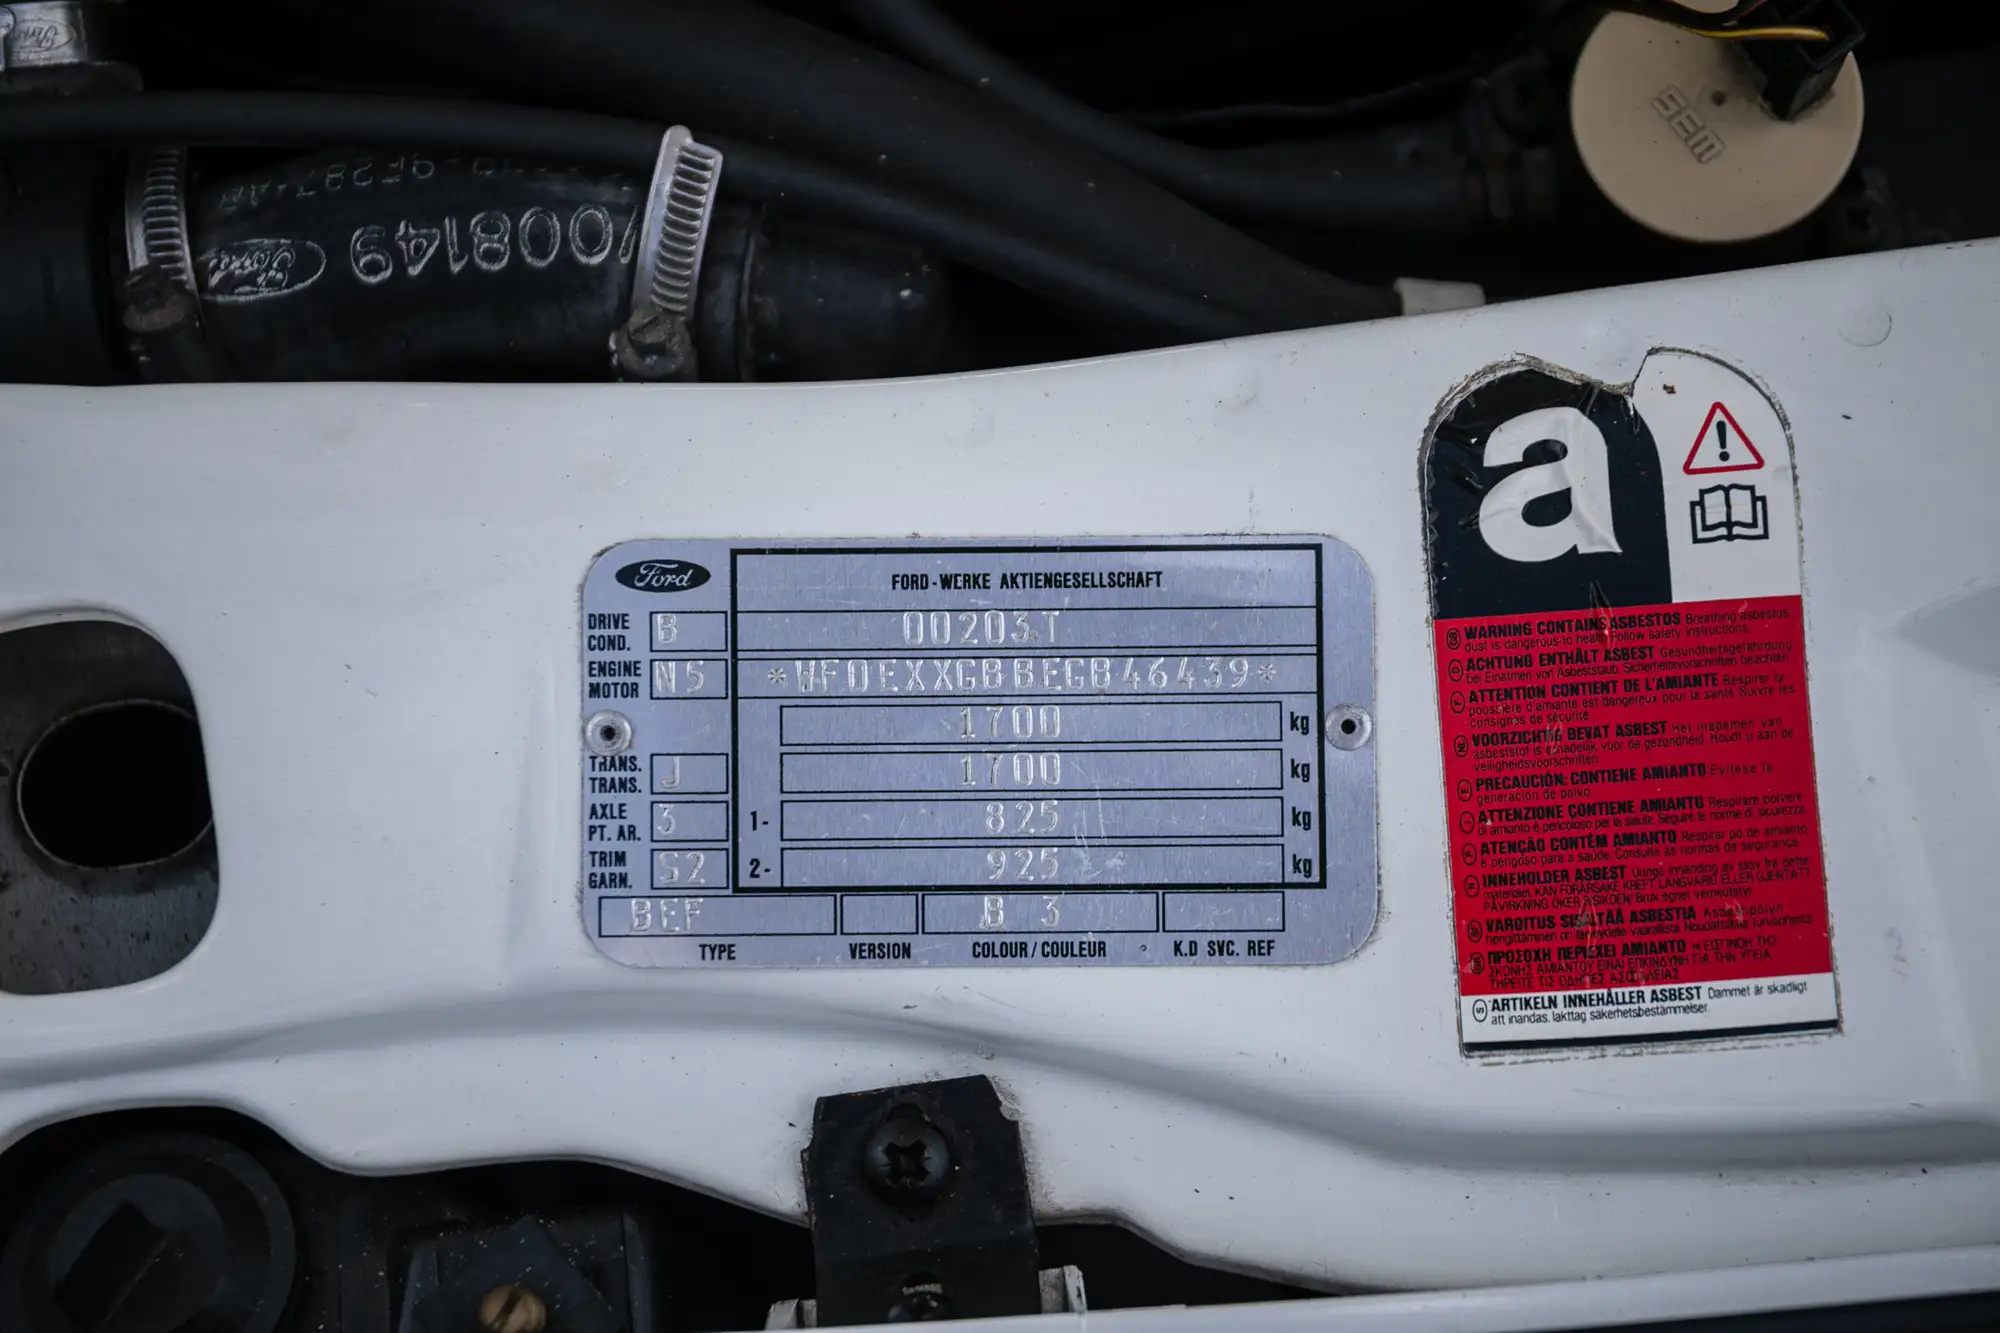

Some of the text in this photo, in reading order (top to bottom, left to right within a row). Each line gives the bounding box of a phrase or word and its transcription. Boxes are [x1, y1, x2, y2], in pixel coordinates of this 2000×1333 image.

[1479, 405, 1623, 563] a
[634, 562, 693, 589] Ford
[1000, 571, 1163, 589] AKTIENGESELLSCHAFT
[588, 613, 630, 630] DRIVE
[656, 613, 678, 645] B
[1463, 621, 1532, 639] WARNING
[1535, 616, 1606, 634] CONTAINS
[1608, 611, 1681, 630] ASBESTOS
[588, 635, 631, 652] COND.
[1463, 640, 1488, 652] dust
[1490, 639, 1501, 650] is
[1503, 635, 1558, 652] dangerous
[1648, 627, 1680, 642] safety
[588, 661, 642, 678] ENGINE
[1465, 645, 1655, 671] ACHTUNG ENTHÄLT ASBEST
[588, 682, 640, 700] MOTOR
[1467, 684, 1546, 703] ATTENTION
[1550, 679, 1618, 698] CONTIENT
[1622, 677, 1640, 693] DE
[1645, 672, 1719, 691] L'AMIANTE
[959, 705, 1310, 739] 1700 kg
[1529, 712, 1542, 724] de
[1566, 723, 1611, 741] BEVAT
[1614, 720, 1669, 738] ASBEST
[960, 752, 1311, 787] 1700 kg
[1569, 766, 1638, 786] CONTIENE
[1642, 762, 1706, 781] AMIANTO
[589, 777, 642, 794] TRANS.
[1542, 788, 1556, 800] de
[588, 803, 627, 820] AXLE
[656, 803, 676, 835] 3
[985, 799, 1060, 834] 825
[1291, 807, 1312, 831] kg
[1477, 804, 1564, 824] ATTENZIONE
[1567, 799, 1636, 818] CONTIENE
[1638, 794, 1704, 813] AMIANTO
[588, 825, 641, 842] PT. AR.
[1478, 834, 1546, 859] ATENÇÃO
[1549, 830, 1608, 851] CONTÉM
[1612, 829, 1677, 847] AMIANTO
[588, 851, 626, 868] TRIM
[985, 846, 1060, 882] 925
[1292, 855, 1313, 878] kg
[588, 872, 633, 890] GARN.
[1481, 864, 1627, 888] INNEHOLDER ASBEST
[629, 897, 705, 935] BEF
[1485, 914, 1556, 933] VAROITUS
[1629, 905, 1696, 924] ASBESTIA
[699, 943, 737, 961] TYPE
[849, 941, 912, 961] VERSION
[1207, 940, 1240, 957] SVC.
[1247, 940, 1276, 957] REF
[1487, 946, 1551, 964] ΠΡΟΣΟΧΗ
[1490, 994, 1557, 1012] ARTIKELN
[1562, 986, 1645, 1008] INNEHÅLLER
[1649, 985, 1702, 1003] ASBEST
[1707, 984, 1750, 999] Dammet
[1766, 980, 1808, 998] skadligt
[1491, 1013, 1504, 1025] att
